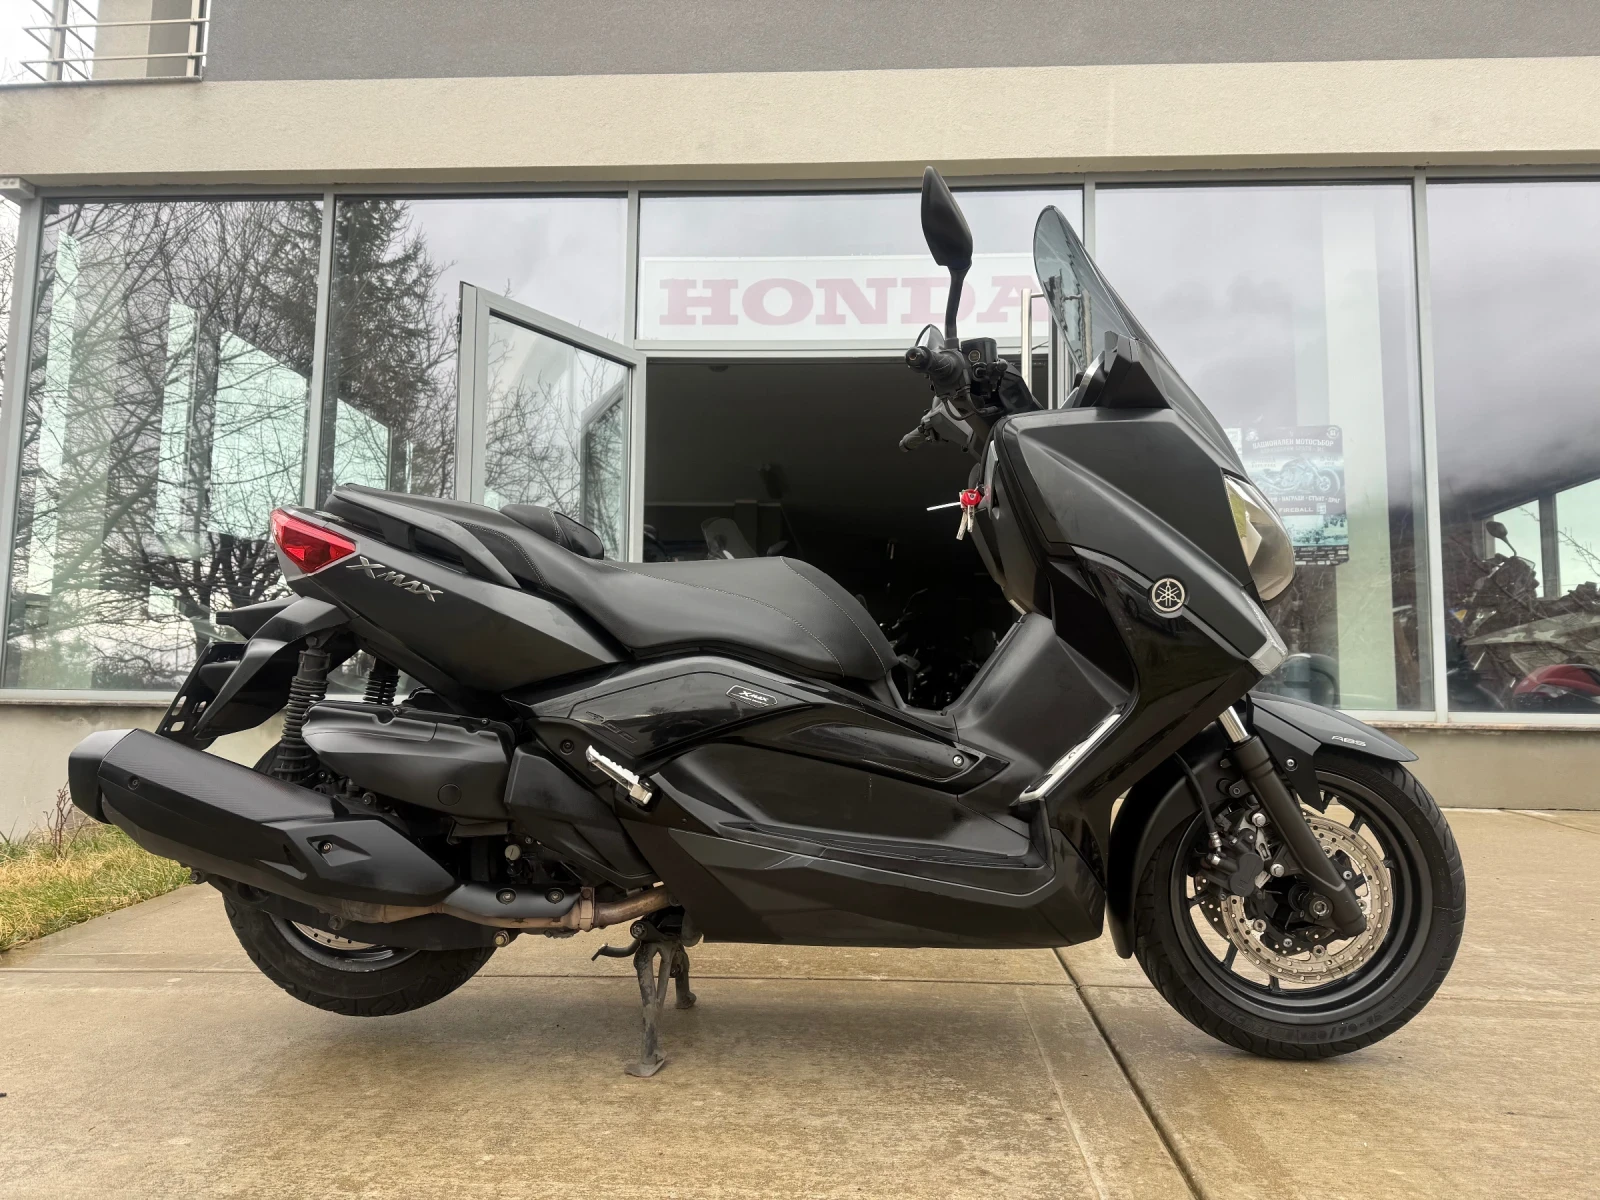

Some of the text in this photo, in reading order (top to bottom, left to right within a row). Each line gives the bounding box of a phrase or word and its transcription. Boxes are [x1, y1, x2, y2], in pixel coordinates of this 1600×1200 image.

[659, 274, 1049, 326] HONDA
[1295, 438, 1334, 447] МОТОСЪБОР
[1331, 735, 1367, 746] ABS
